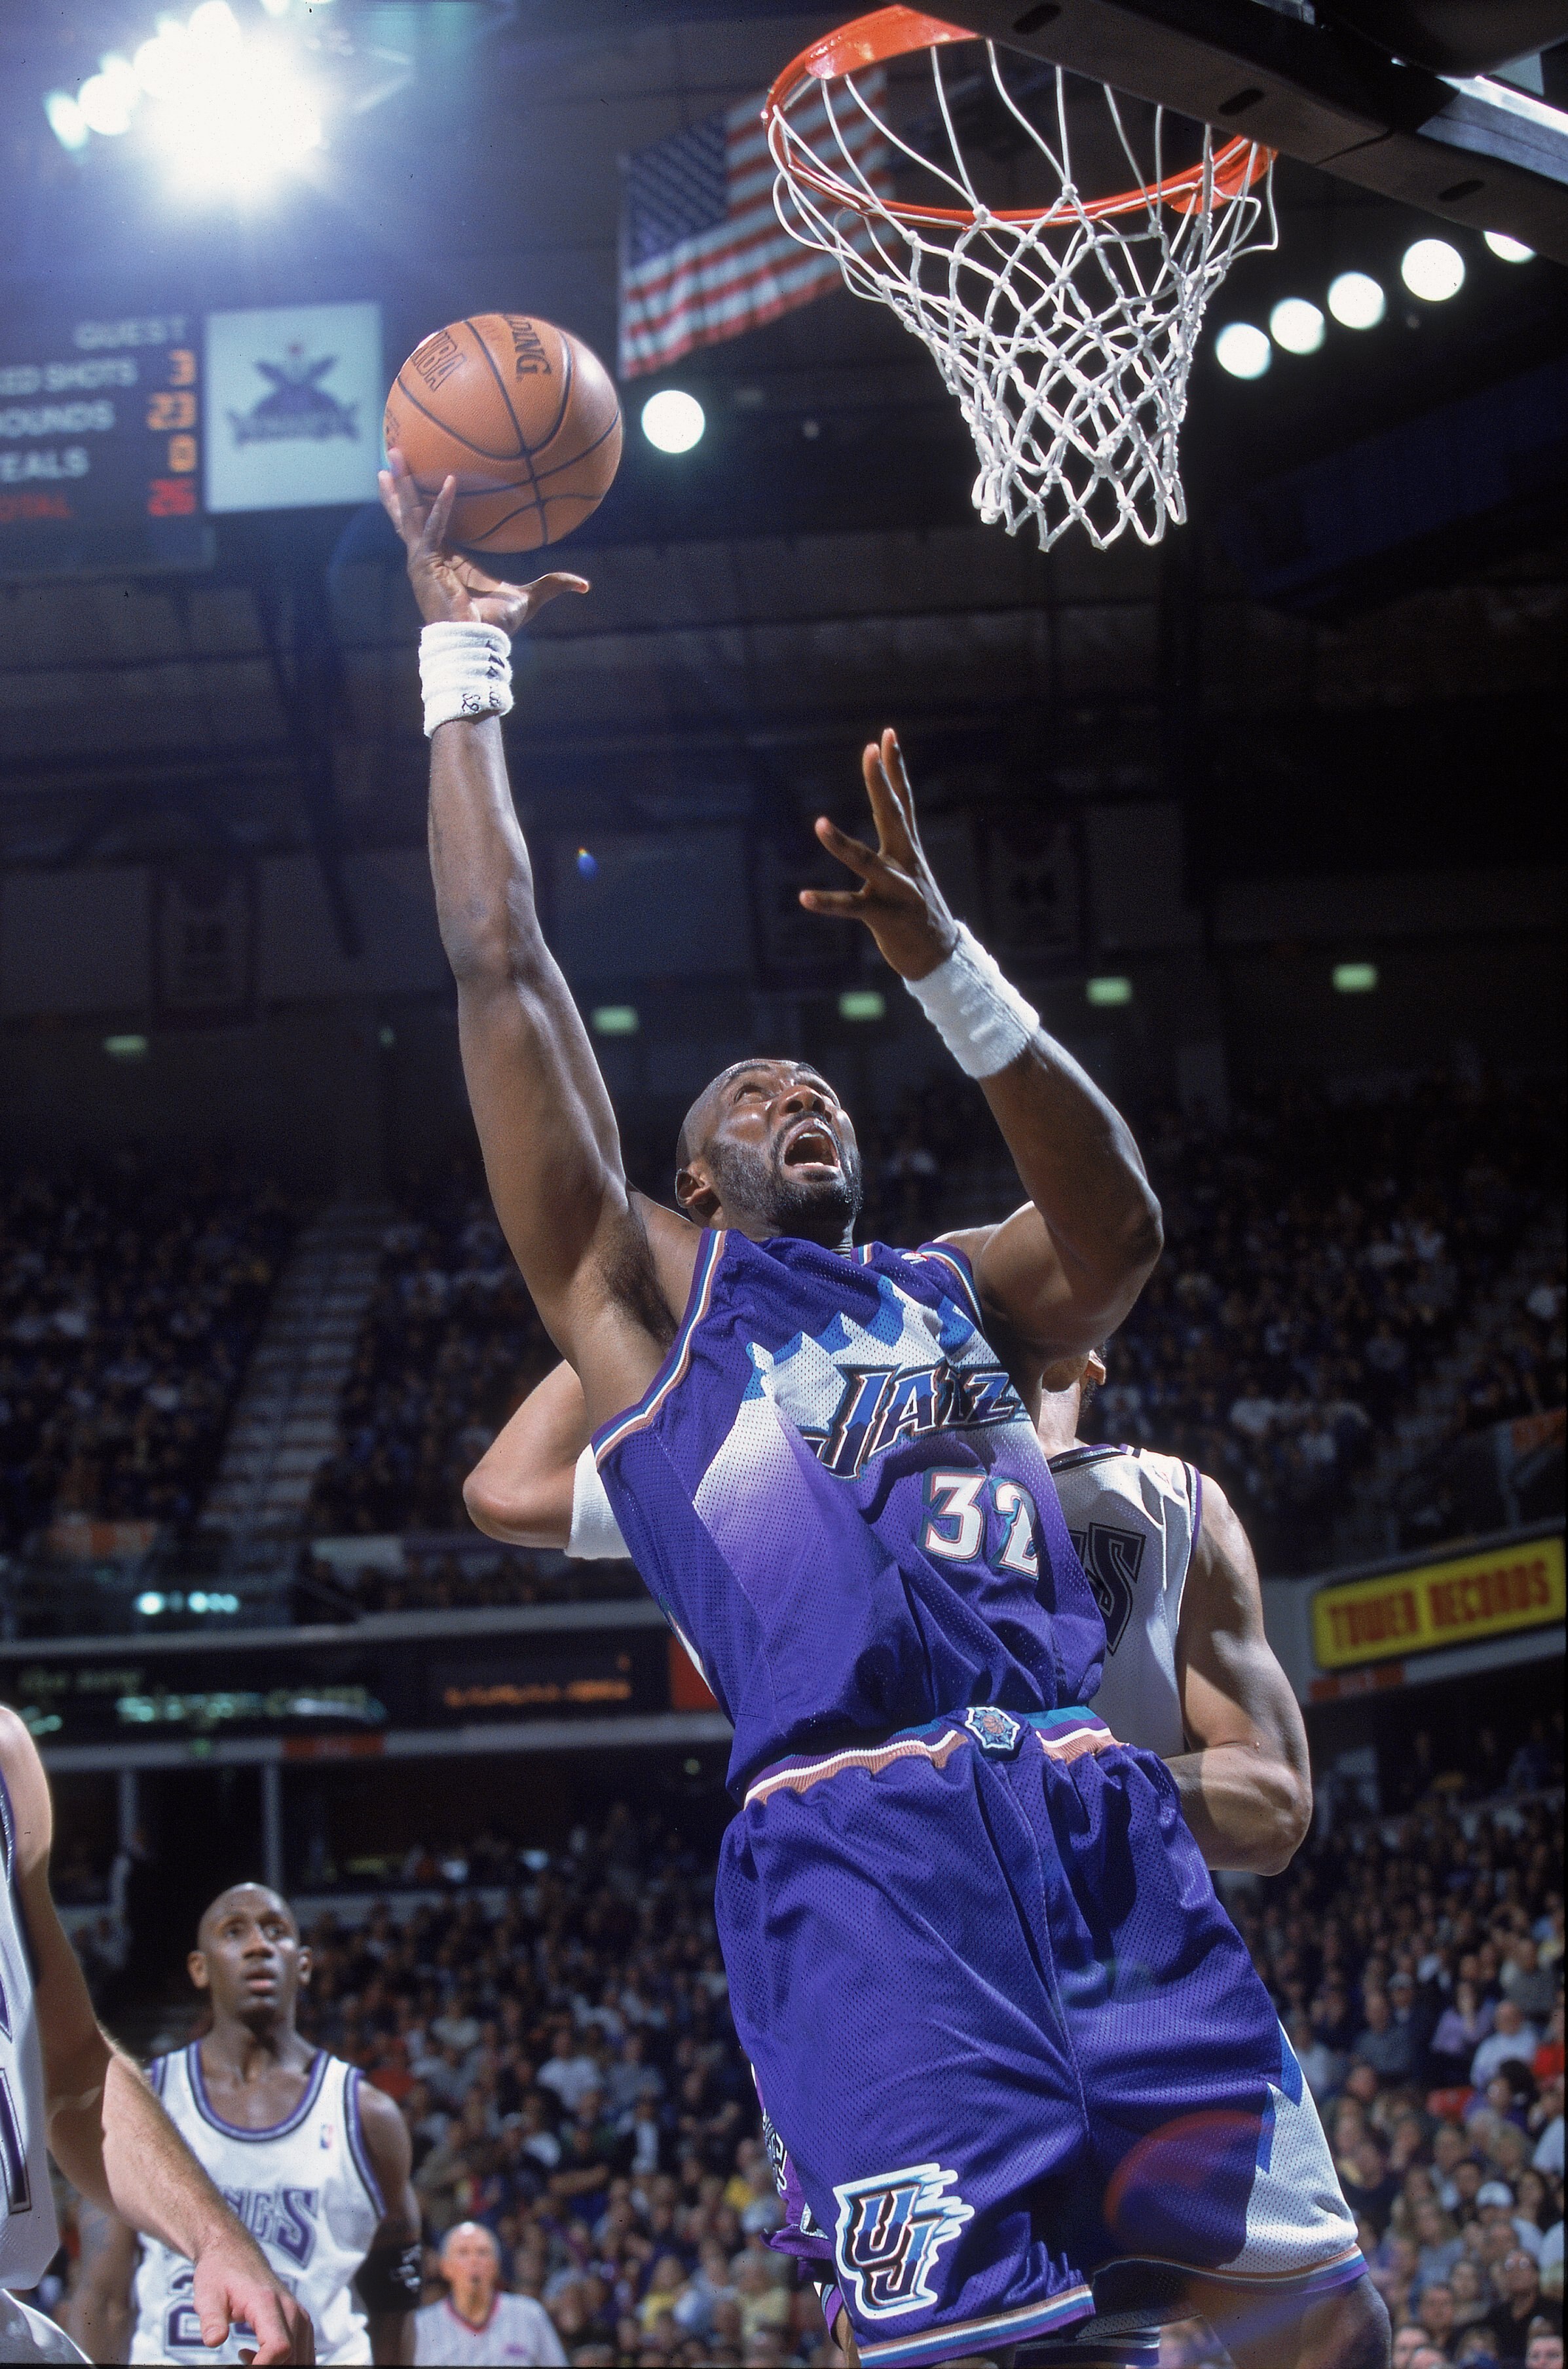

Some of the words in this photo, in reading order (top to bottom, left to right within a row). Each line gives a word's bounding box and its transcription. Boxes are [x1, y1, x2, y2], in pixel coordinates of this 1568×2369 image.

[74, 315, 187, 349] GUEST
[44, 356, 138, 392] SHOTS
[169, 349, 196, 386] 3
[410, 330, 467, 393] NBA
[147, 391, 196, 430] 23
[922, 1467, 1039, 1580] 32
